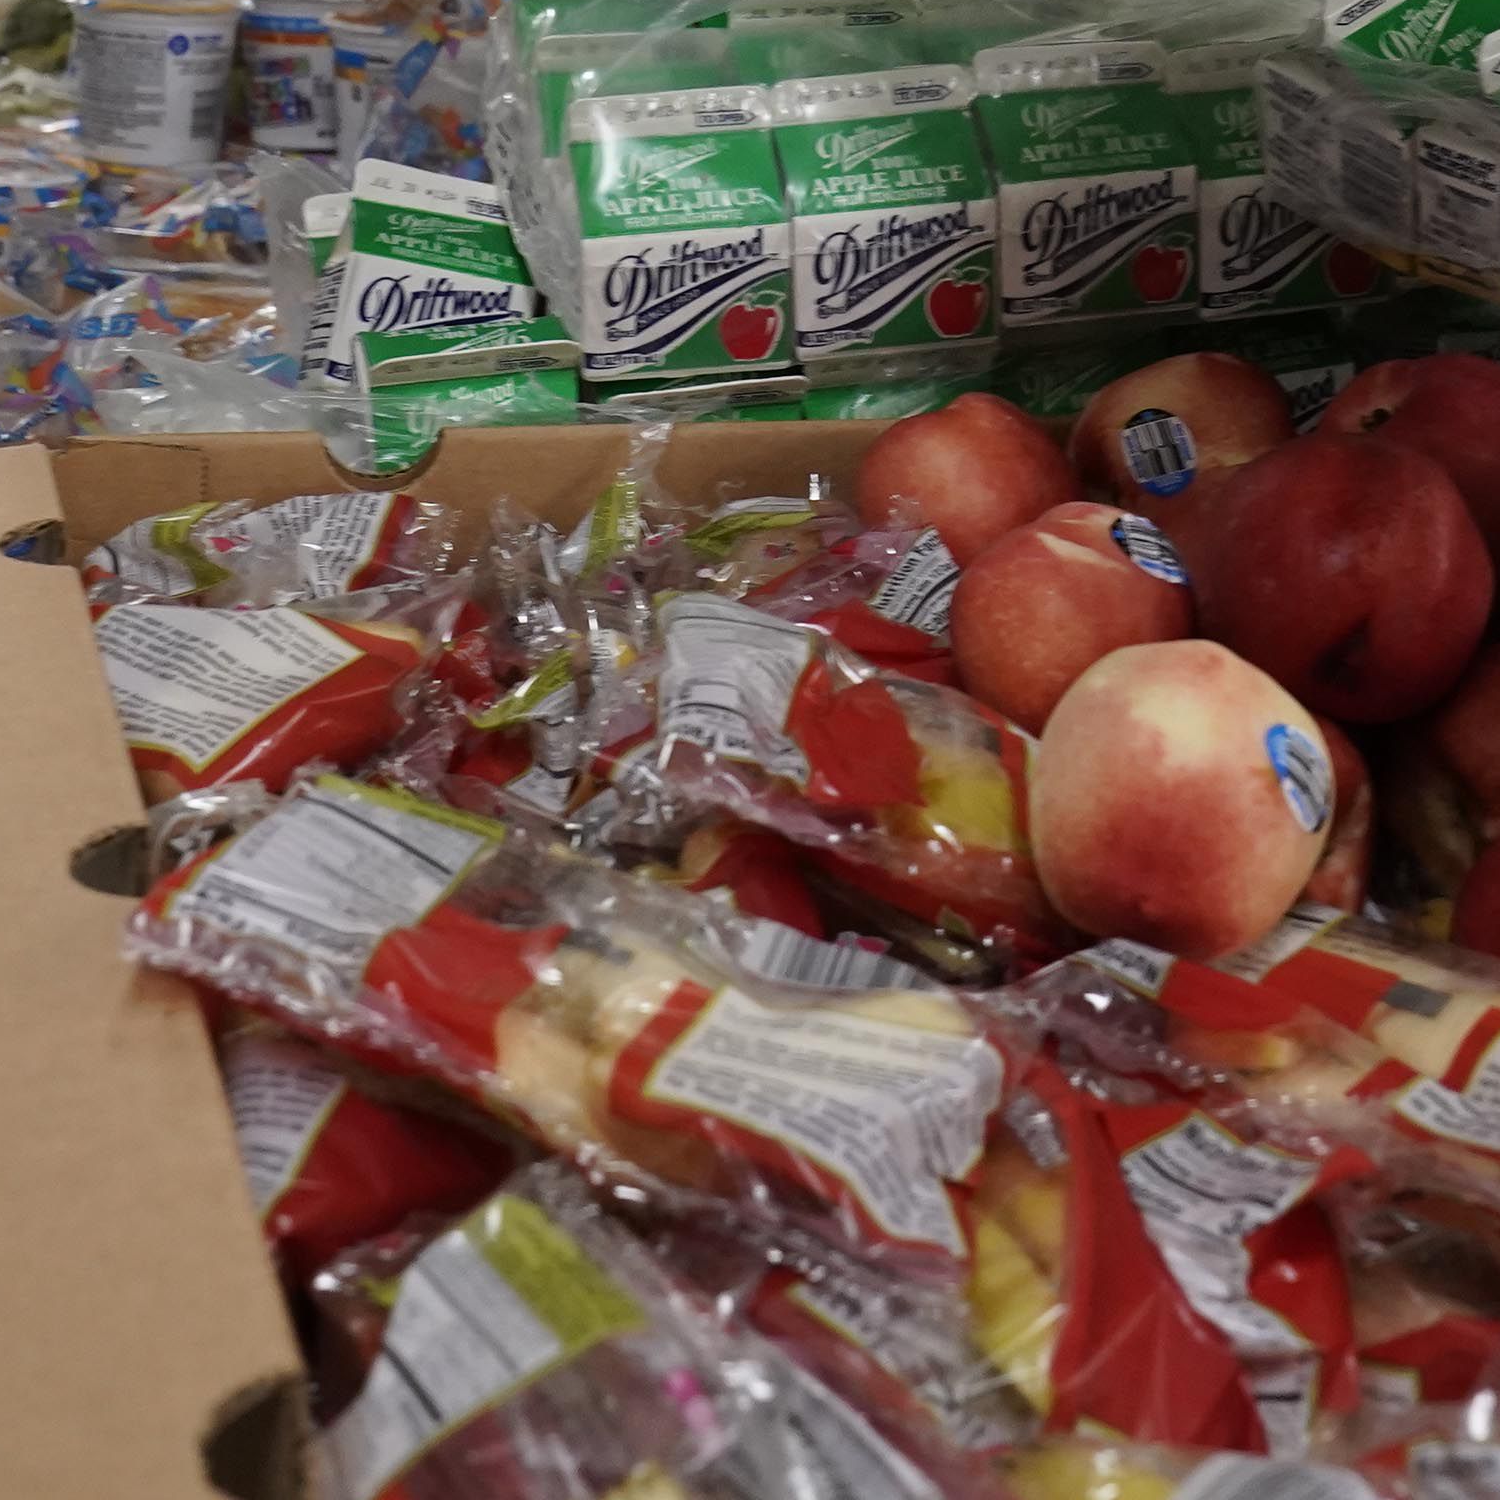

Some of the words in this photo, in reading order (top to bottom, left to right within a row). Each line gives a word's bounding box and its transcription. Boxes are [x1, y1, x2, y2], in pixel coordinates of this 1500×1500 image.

[604, 191, 685, 217] APPLE
[688, 186, 762, 211] JUICE
[811, 171, 889, 198] APPLE
[894, 163, 967, 188] JUICE
[373, 232, 445, 253] APPLE
[1022, 170, 1174, 271] Driftwood
[604, 228, 764, 328] Driftwood
[814, 201, 970, 306] Driftwood
[359, 274, 513, 332] Driftwood
